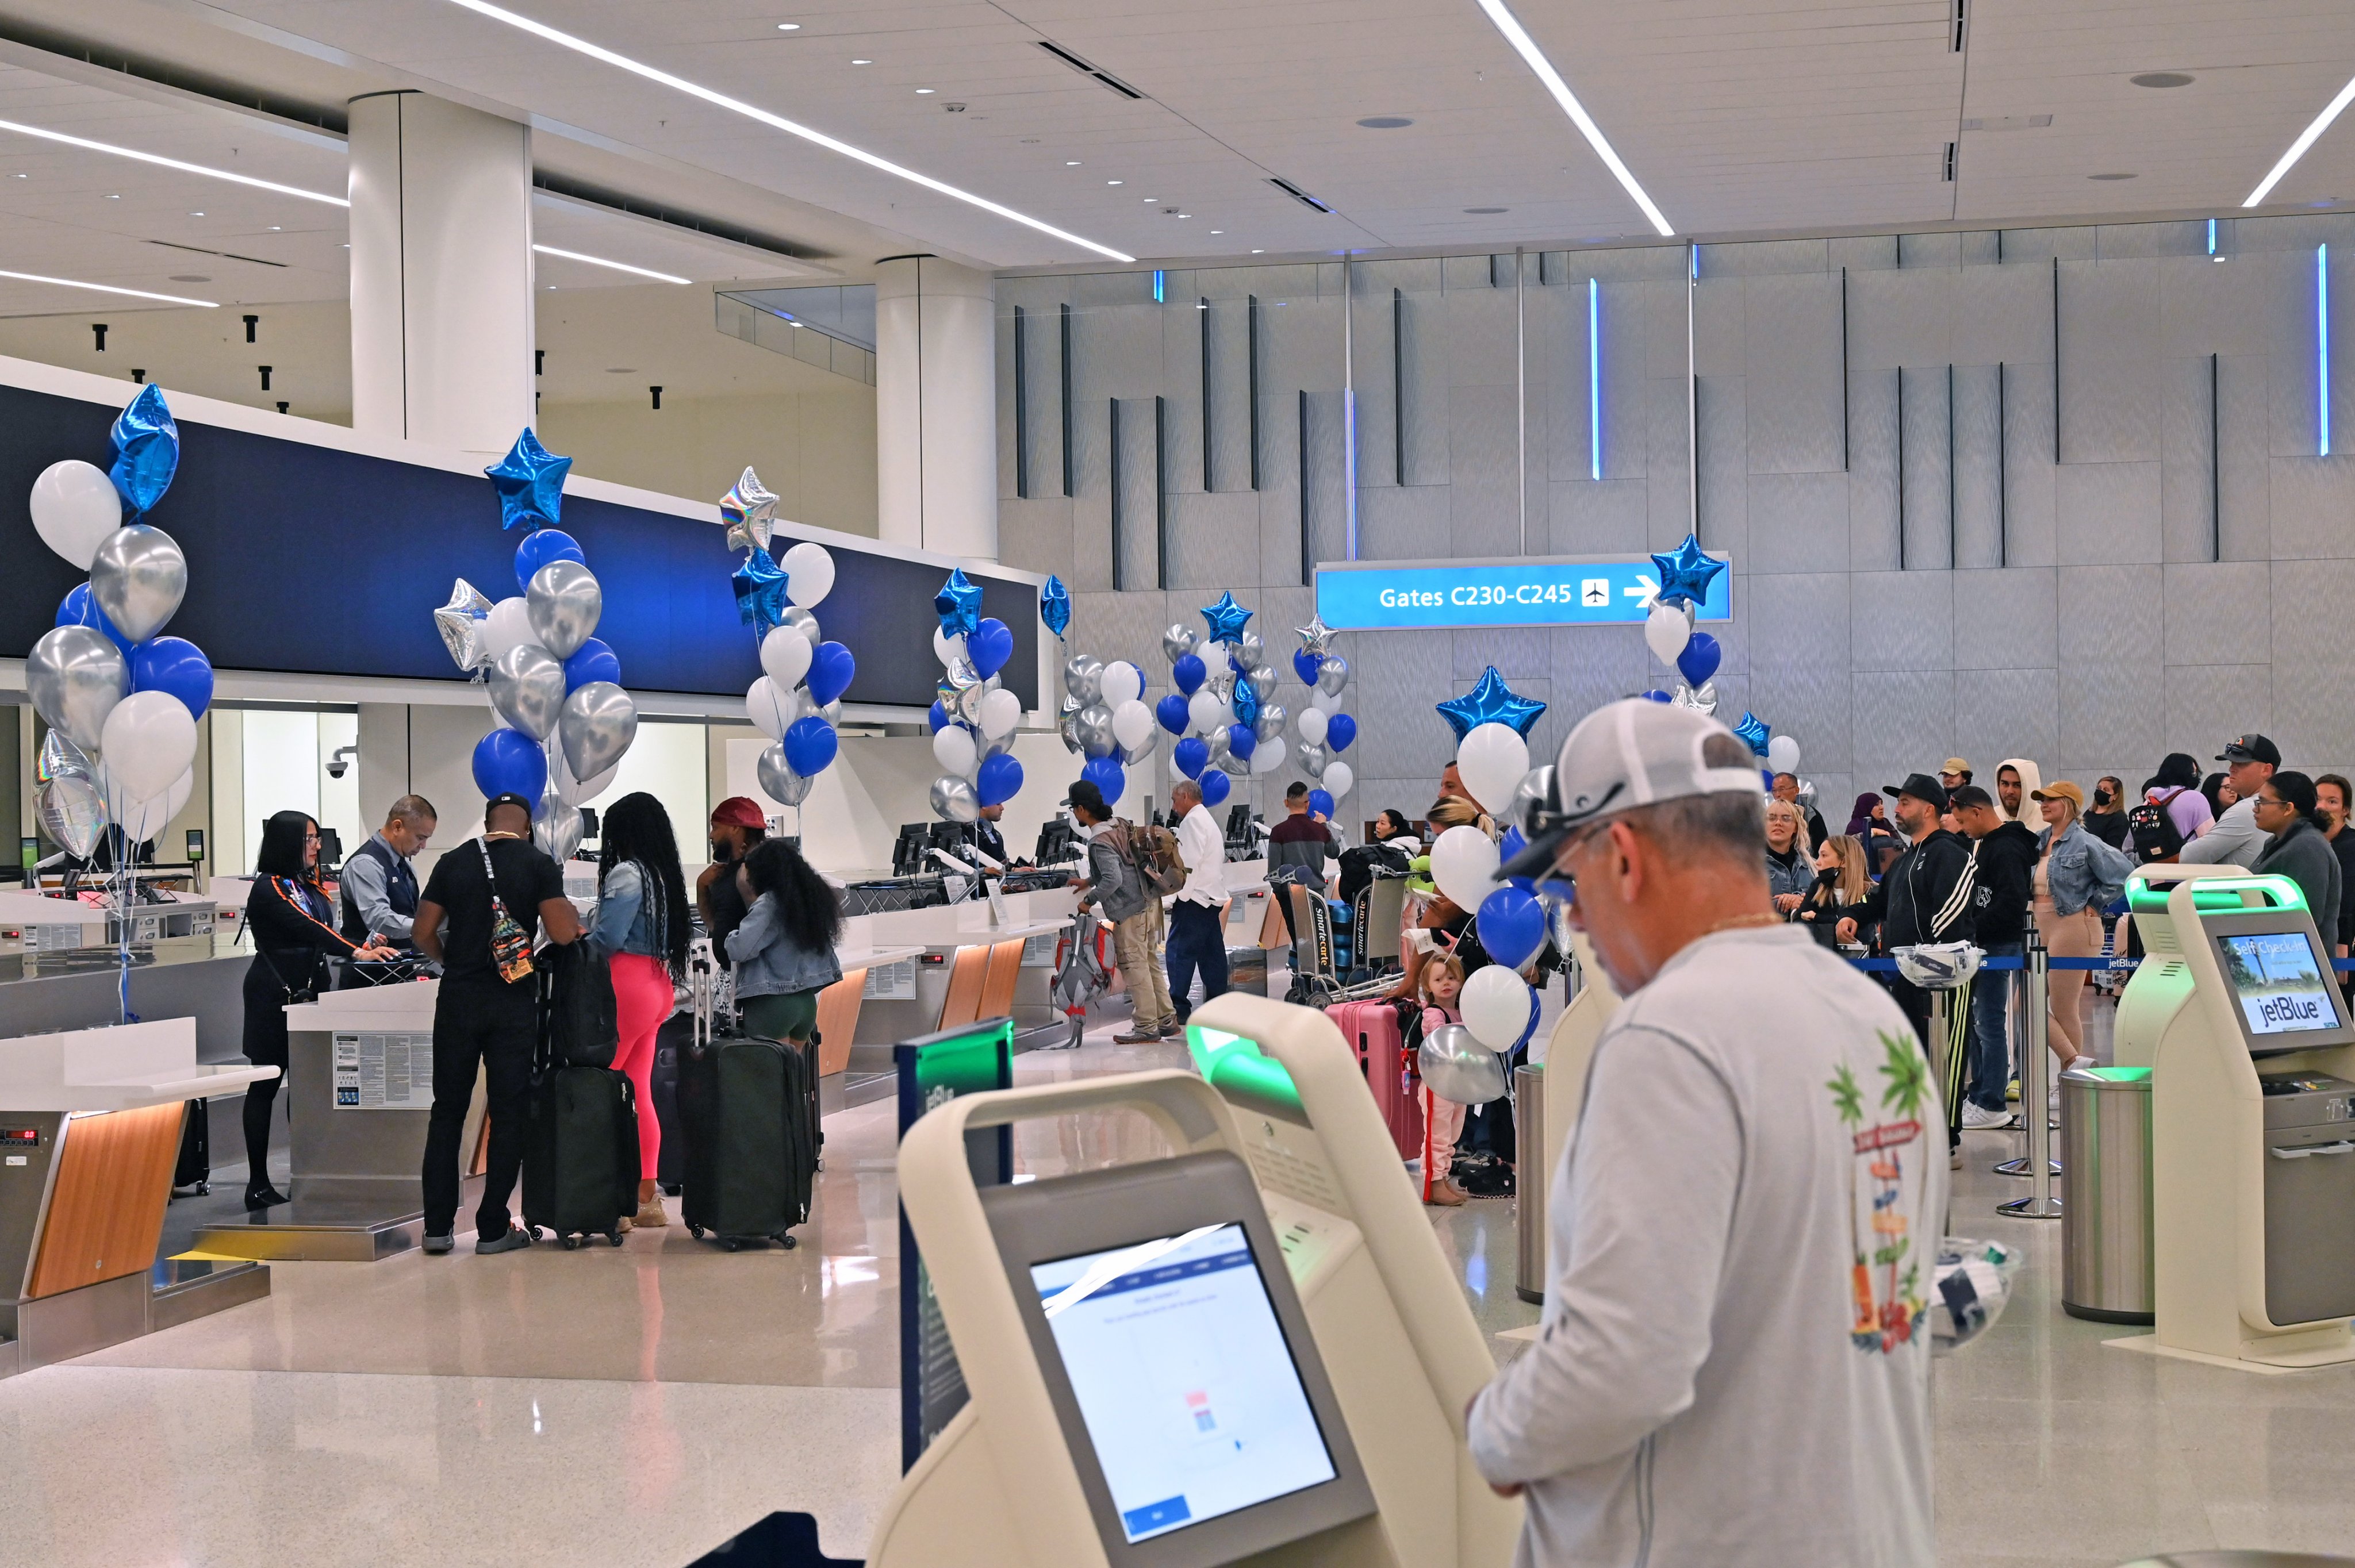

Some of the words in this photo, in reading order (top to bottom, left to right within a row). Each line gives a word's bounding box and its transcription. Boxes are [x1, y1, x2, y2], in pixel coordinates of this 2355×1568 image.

[1379, 588, 1443, 608] Gates
[1451, 584, 1572, 606] C230-C245
[2233, 941, 2257, 956] Self
[2258, 939, 2307, 954] Check-In
[2108, 958, 2139, 970] jetBlue
[2257, 996, 2319, 1028] jetBlue
